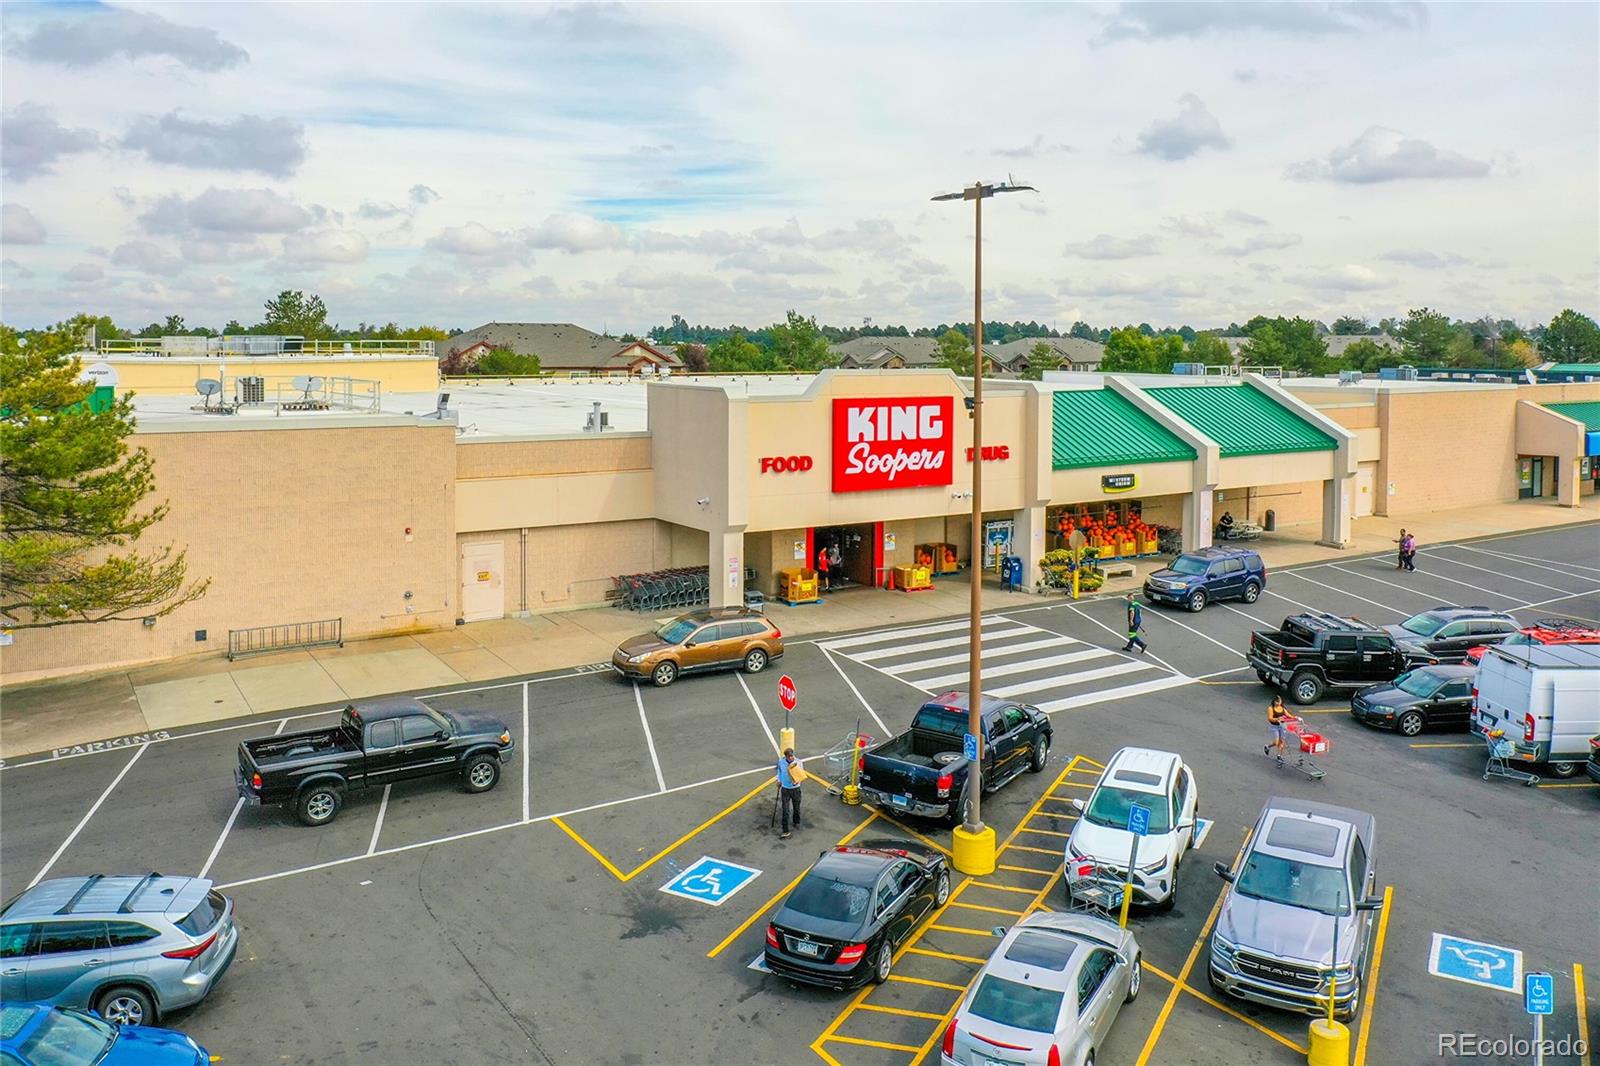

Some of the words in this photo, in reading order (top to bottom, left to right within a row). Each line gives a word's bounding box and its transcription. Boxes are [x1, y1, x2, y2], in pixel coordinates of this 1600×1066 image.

[848, 405, 943, 442] KING
[760, 455, 813, 474] FOOD
[845, 442, 945, 481] Soopers
[779, 682, 796, 703] STOP
[52, 731, 170, 759] PARKING
[1259, 964, 1295, 978] RAM
